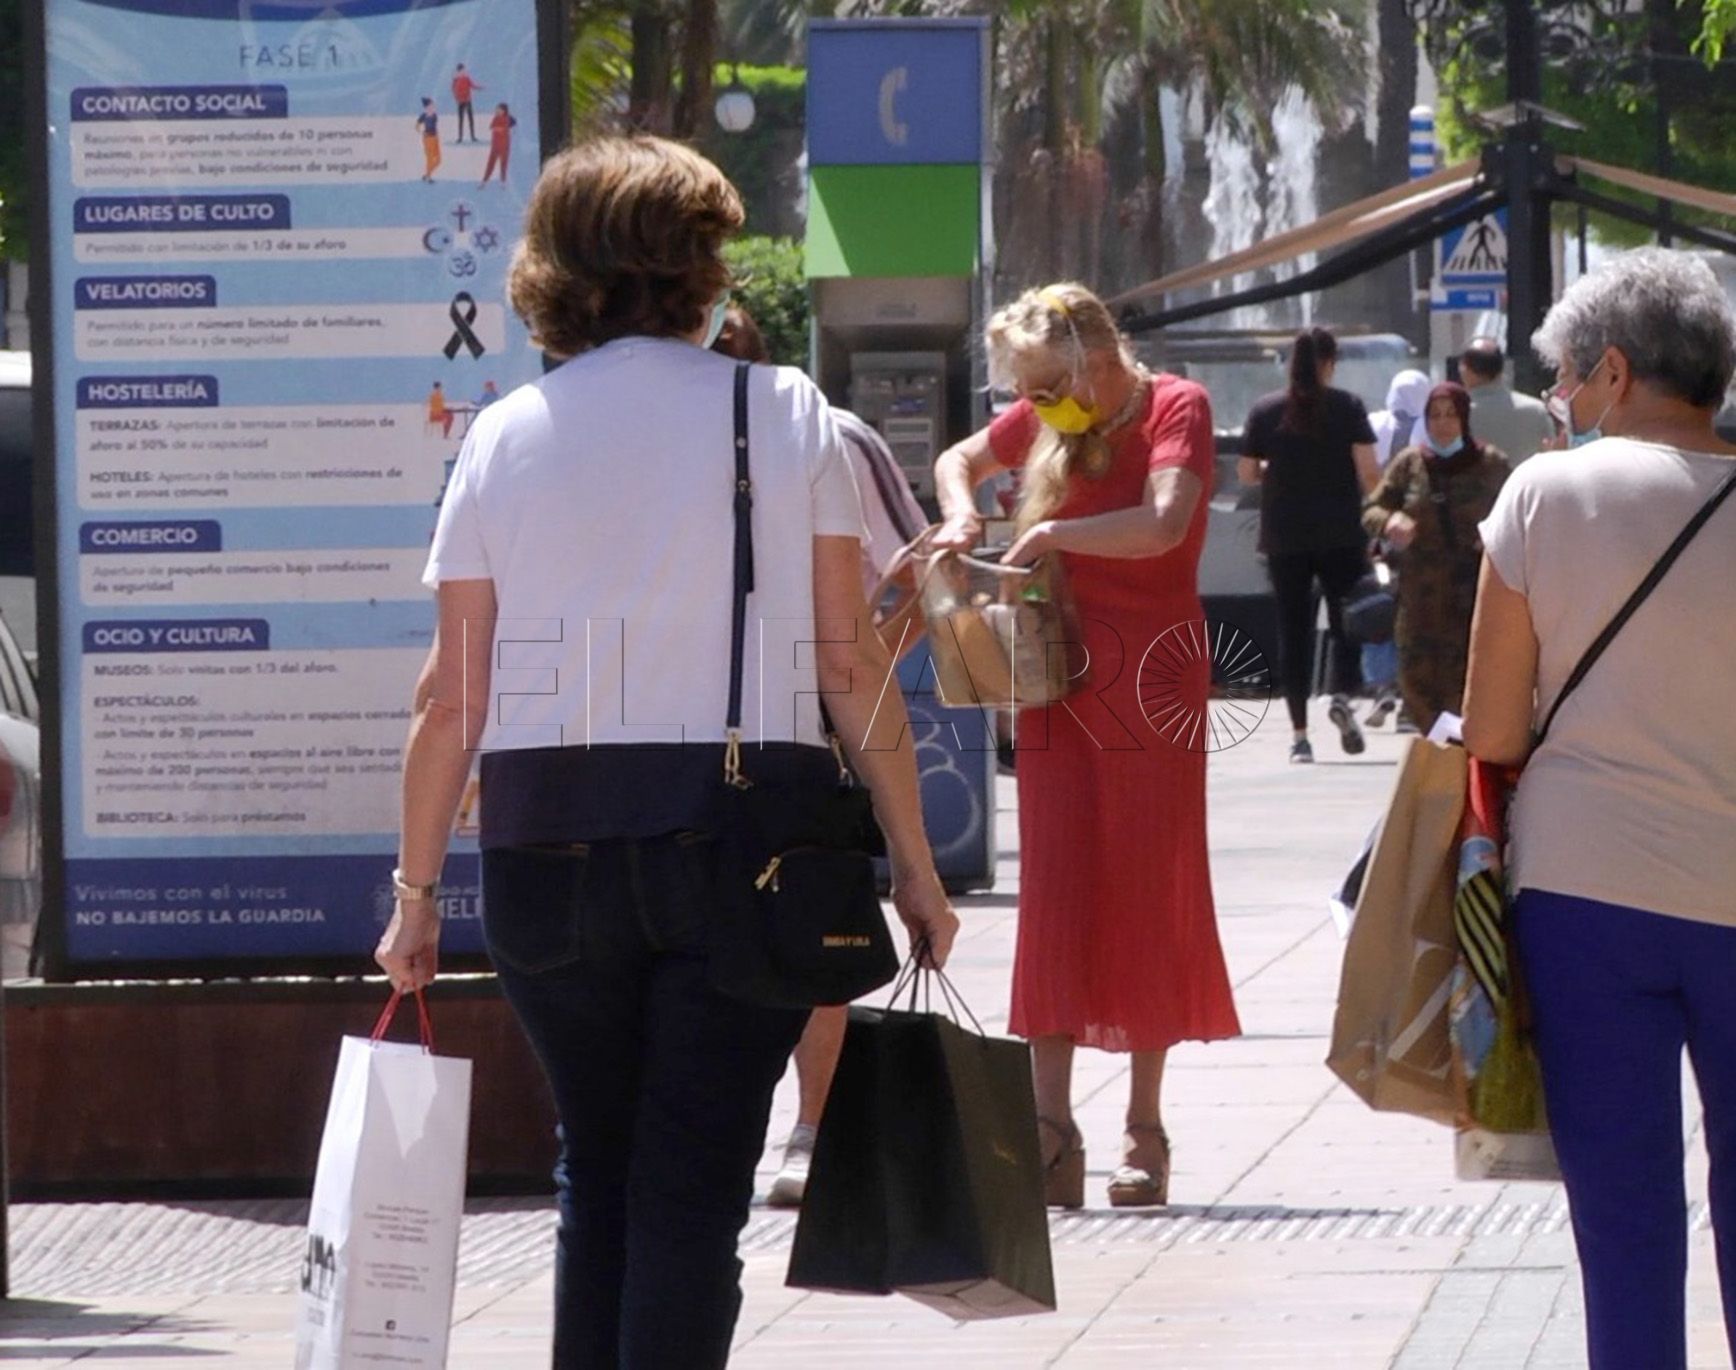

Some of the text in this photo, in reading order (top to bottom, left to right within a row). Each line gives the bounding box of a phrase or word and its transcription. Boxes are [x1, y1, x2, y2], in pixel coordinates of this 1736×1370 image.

[239, 44, 338, 68] FASE 1
[82, 94, 266, 113] CONTACTO SOCIAL
[167, 133, 209, 145] grupos
[214, 130, 274, 142] reducidos
[278, 130, 295, 141] de
[299, 129, 314, 140] 10
[317, 130, 374, 142] personas
[199, 164, 225, 177] bajo
[229, 163, 302, 174] condiciones
[306, 161, 322, 172] de
[326, 160, 388, 174] seguridad
[84, 203, 274, 223] LUGARES DE CULTO
[86, 242, 142, 254] Permitido
[147, 243, 166, 253] con
[233, 239, 247, 250] de
[253, 239, 272, 250] 1/3
[276, 239, 292, 250] de
[297, 241, 310, 250] su
[314, 238, 346, 250] aforo
[86, 282, 206, 299] VELATORIOS
[87, 320, 144, 331] Permitido
[148, 321, 175, 332] para
[179, 321, 194, 330] un
[248, 317, 298, 328] limitado
[302, 317, 318, 328] de
[87, 338, 109, 347] con
[113, 336, 165, 347] distancia
[211, 335, 226, 345] de
[230, 334, 289, 347] seguridad
[88, 379, 207, 400] HOSTELERÍA
[165, 420, 218, 431] Apertura
[222, 418, 237, 429] de
[240, 418, 287, 429] terrazas
[379, 415, 395, 427] de
[90, 440, 122, 450] aforo
[126, 439, 136, 450] al
[140, 439, 168, 450] 50%
[172, 439, 186, 449] de
[207, 438, 268, 450] capacidad
[158, 471, 211, 483] Apertura
[215, 470, 229, 480] de
[233, 469, 276, 480] hoteles
[280, 470, 301, 479] con
[306, 468, 382, 479] restricciones
[386, 467, 402, 478] de
[116, 489, 131, 499] en
[135, 489, 170, 498] zonas
[174, 488, 228, 498] comunes
[92, 528, 197, 545] COMERCIO
[93, 561, 390, 577] Apertura de pequeño comercio bajo condiciones
[93, 580, 174, 595] de seguridad
[94, 627, 255, 645] OCIO Y CULTURA
[188, 664, 225, 674] visitas
[229, 664, 251, 674] con
[256, 662, 276, 673] 1/3
[280, 661, 299, 673] del
[290, 712, 304, 721] en
[308, 710, 361, 723] espacios
[365, 708, 412, 720] cerrado
[94, 730, 116, 739] con
[159, 728, 174, 738] de
[198, 728, 254, 740] personas
[250, 749, 301, 761] espacios
[306, 747, 316, 758] al
[320, 747, 342, 758] aire
[347, 746, 374, 757] libre
[378, 748, 401, 758] con
[148, 764, 163, 775] de
[248, 780, 264, 790] de
[74, 884, 287, 901] Vivimos con el virus
[76, 908, 325, 925] NO BAJEMOS LA GUARDIA
